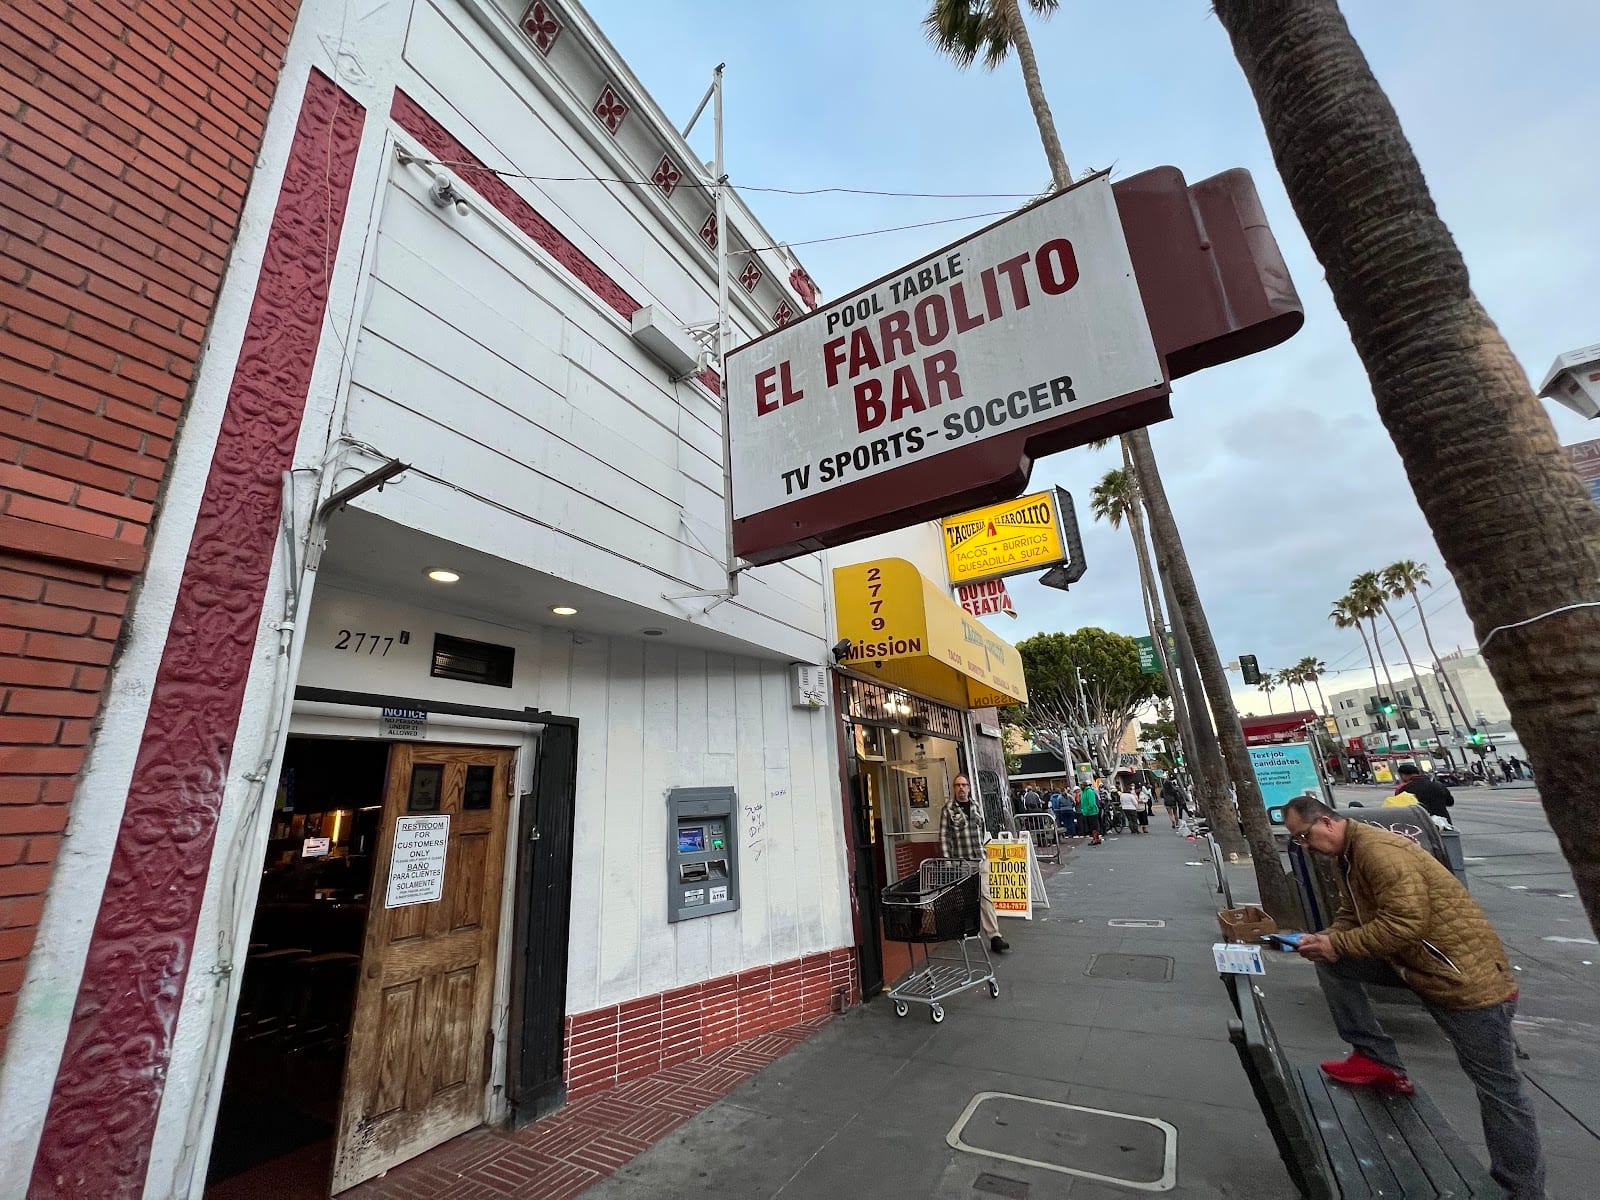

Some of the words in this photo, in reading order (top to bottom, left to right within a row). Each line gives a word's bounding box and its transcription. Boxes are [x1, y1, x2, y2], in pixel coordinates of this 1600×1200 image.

[827, 294, 883, 335] POOL
[889, 253, 964, 305] TABLE
[754, 360, 803, 417] EL
[823, 238, 1080, 387] FAROLITO
[854, 349, 964, 433] BAR
[781, 465, 811, 495] TV
[947, 521, 986, 548] TAQUERIA
[995, 517, 1001, 525] EL
[1001, 502, 1050, 525] FAROLITO
[956, 548, 988, 561] TACOS
[1003, 533, 1048, 551] BURRITOS
[958, 554, 1016, 572] QUESADILLA
[1021, 546, 1049, 559] SUIZA
[334, 629, 394, 657] 2777
[384, 708, 425, 718] NOTICE
[388, 729, 418, 737] ALLOWED
[1271, 751, 1284, 759] job
[1254, 759, 1300, 767] candidates
[402, 822, 444, 831] RESTROOM
[414, 831, 430, 839] FOR
[397, 839, 444, 849] CUSTOMERS
[409, 850, 430, 858] ONLY
[990, 861, 1027, 873] UTDOOR
[393, 872, 410, 881] PARA
[411, 869, 441, 879] CLIENTES
[989, 874, 1016, 886] EATING
[1018, 874, 1027, 887] IN
[396, 879, 435, 891] SOLAMENTE
[989, 886, 1001, 899] HE
[1004, 887, 1027, 900] BACK
